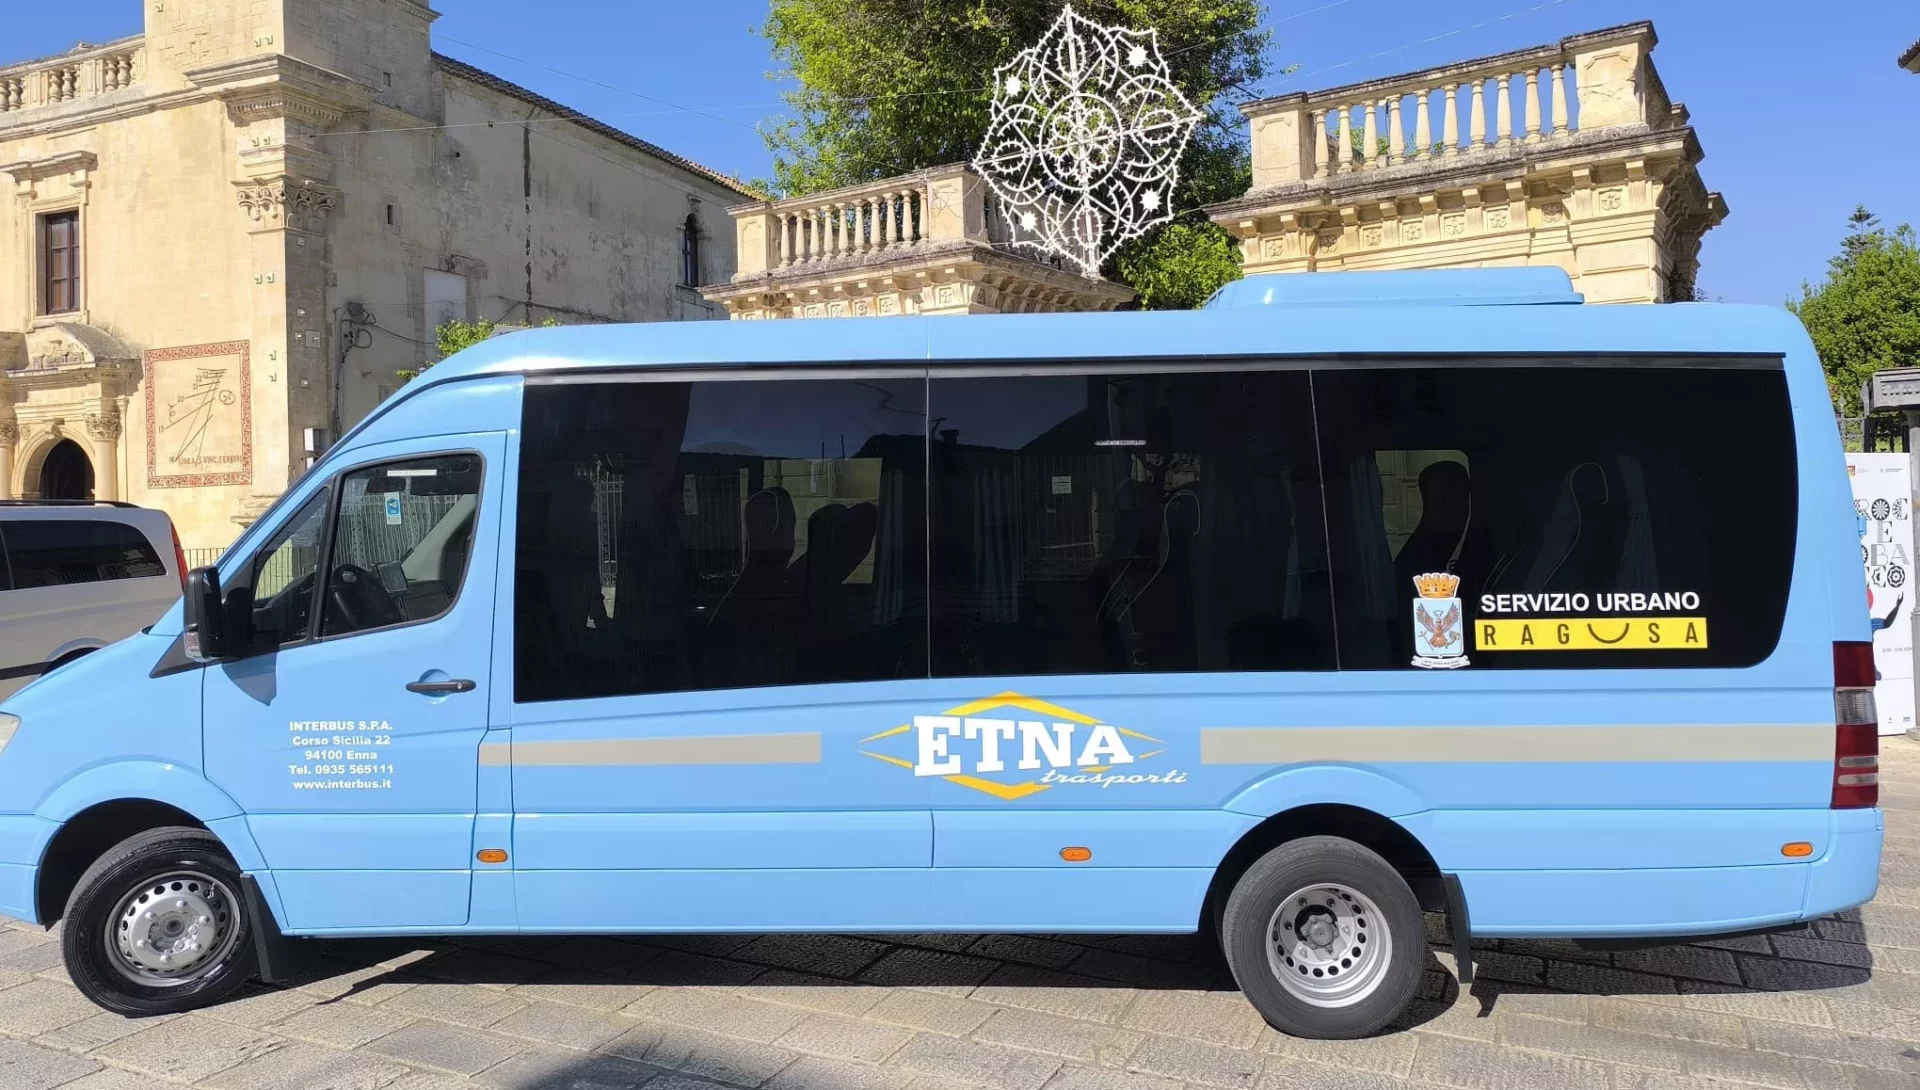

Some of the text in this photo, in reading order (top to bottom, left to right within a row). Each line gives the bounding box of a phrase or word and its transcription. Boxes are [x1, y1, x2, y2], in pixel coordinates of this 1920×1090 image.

[1877, 521, 1893, 543] E
[1481, 592, 1700, 613] SERVIZIO URBANO
[290, 721, 393, 731] INTERBUS S.P.A.
[292, 735, 391, 746] Corso Sicilia 22
[914, 714, 1135, 778] ETNA
[305, 750, 377, 760] 94100 Enna
[289, 764, 394, 775] Tel. 0935 565111
[1040, 767, 1188, 789] trasporti
[293, 779, 392, 789] www.interbus.it
